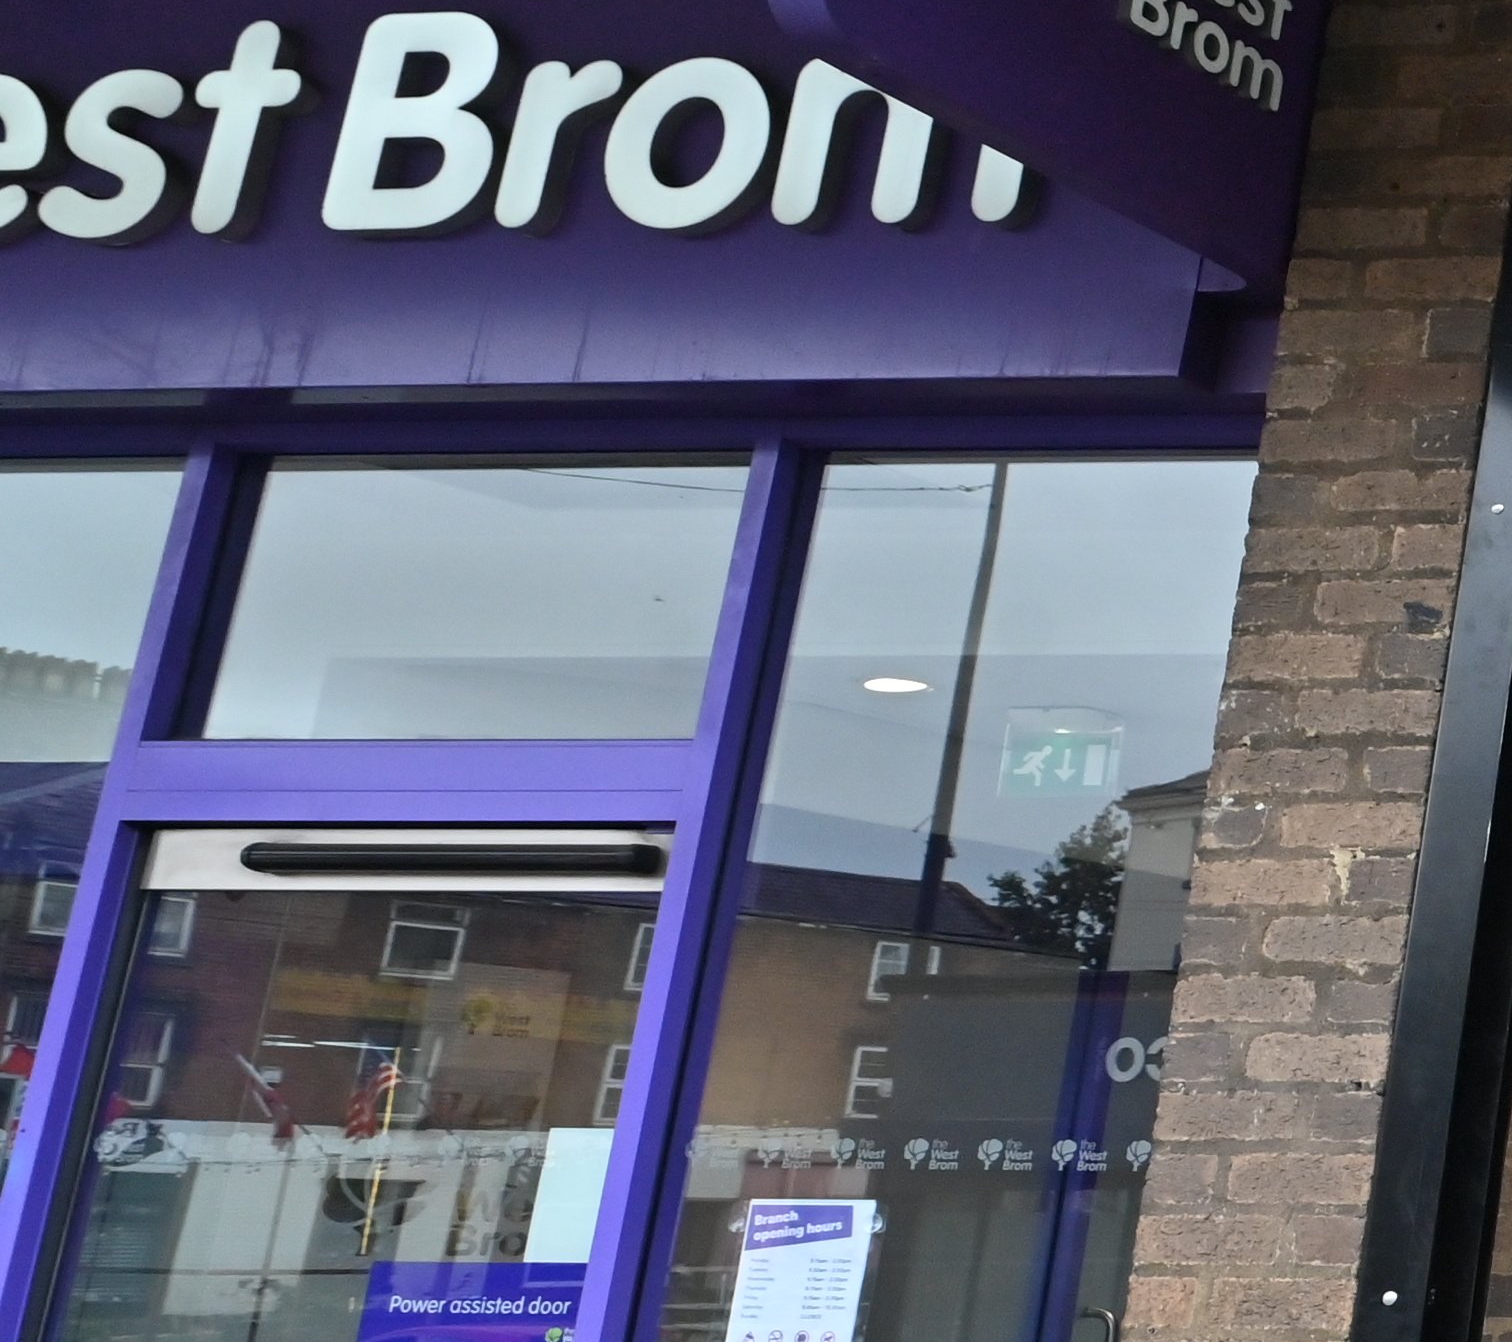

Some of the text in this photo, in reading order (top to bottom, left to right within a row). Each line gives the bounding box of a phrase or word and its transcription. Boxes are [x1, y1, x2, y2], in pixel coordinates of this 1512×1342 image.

[931, 1149, 959, 1160] West
[1004, 1149, 1033, 1160] West
[1079, 1150, 1107, 1161] West
[855, 1160, 885, 1170] Brom
[928, 1160, 958, 1170] Brom
[1002, 1161, 1032, 1171] Brom
[1076, 1161, 1107, 1171] Brom
[754, 1210, 799, 1226] Branch
[753, 1221, 843, 1242] opening hours
[389, 1296, 572, 1314] Power assisted door
